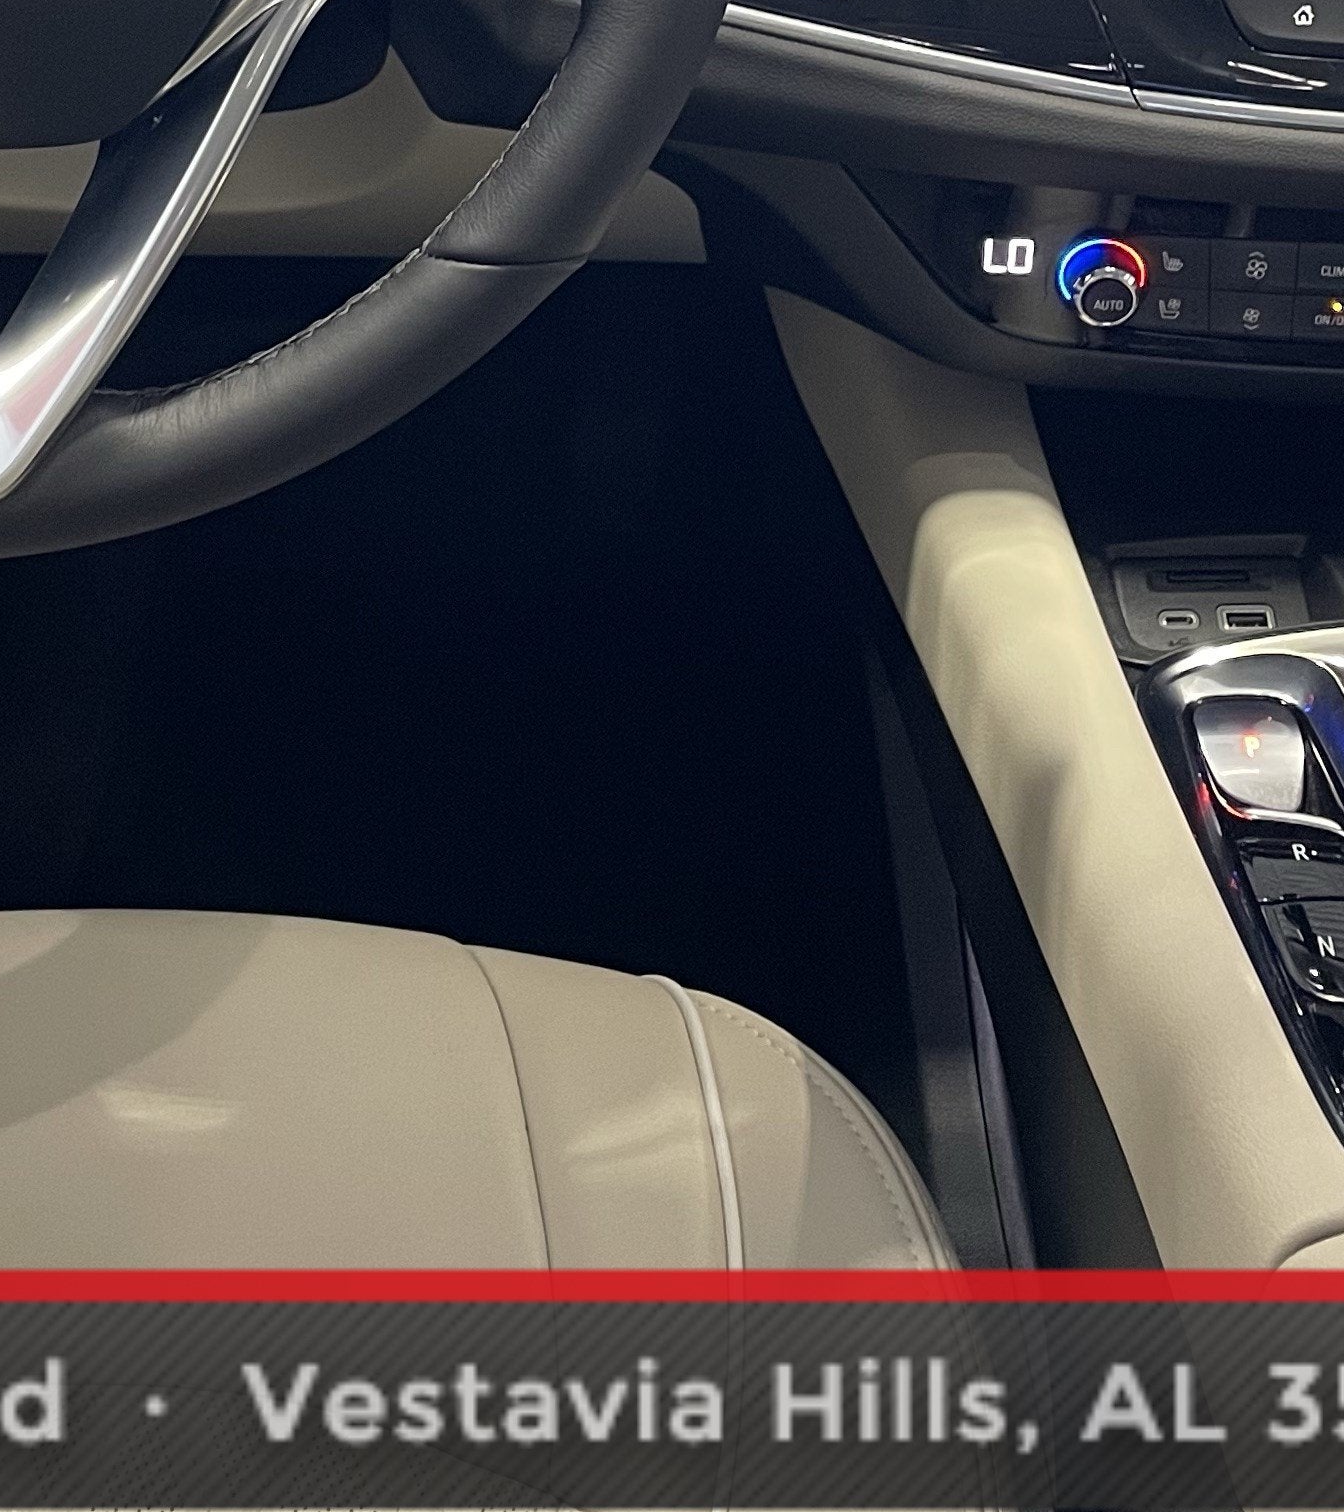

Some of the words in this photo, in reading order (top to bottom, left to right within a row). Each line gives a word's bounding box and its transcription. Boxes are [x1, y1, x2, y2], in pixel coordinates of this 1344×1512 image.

[982, 237, 1034, 274] LO
[1094, 299, 1124, 311] AUTO
[1242, 735, 1260, 757] P
[1292, 844, 1308, 860] R
[1317, 936, 1336, 957] N
